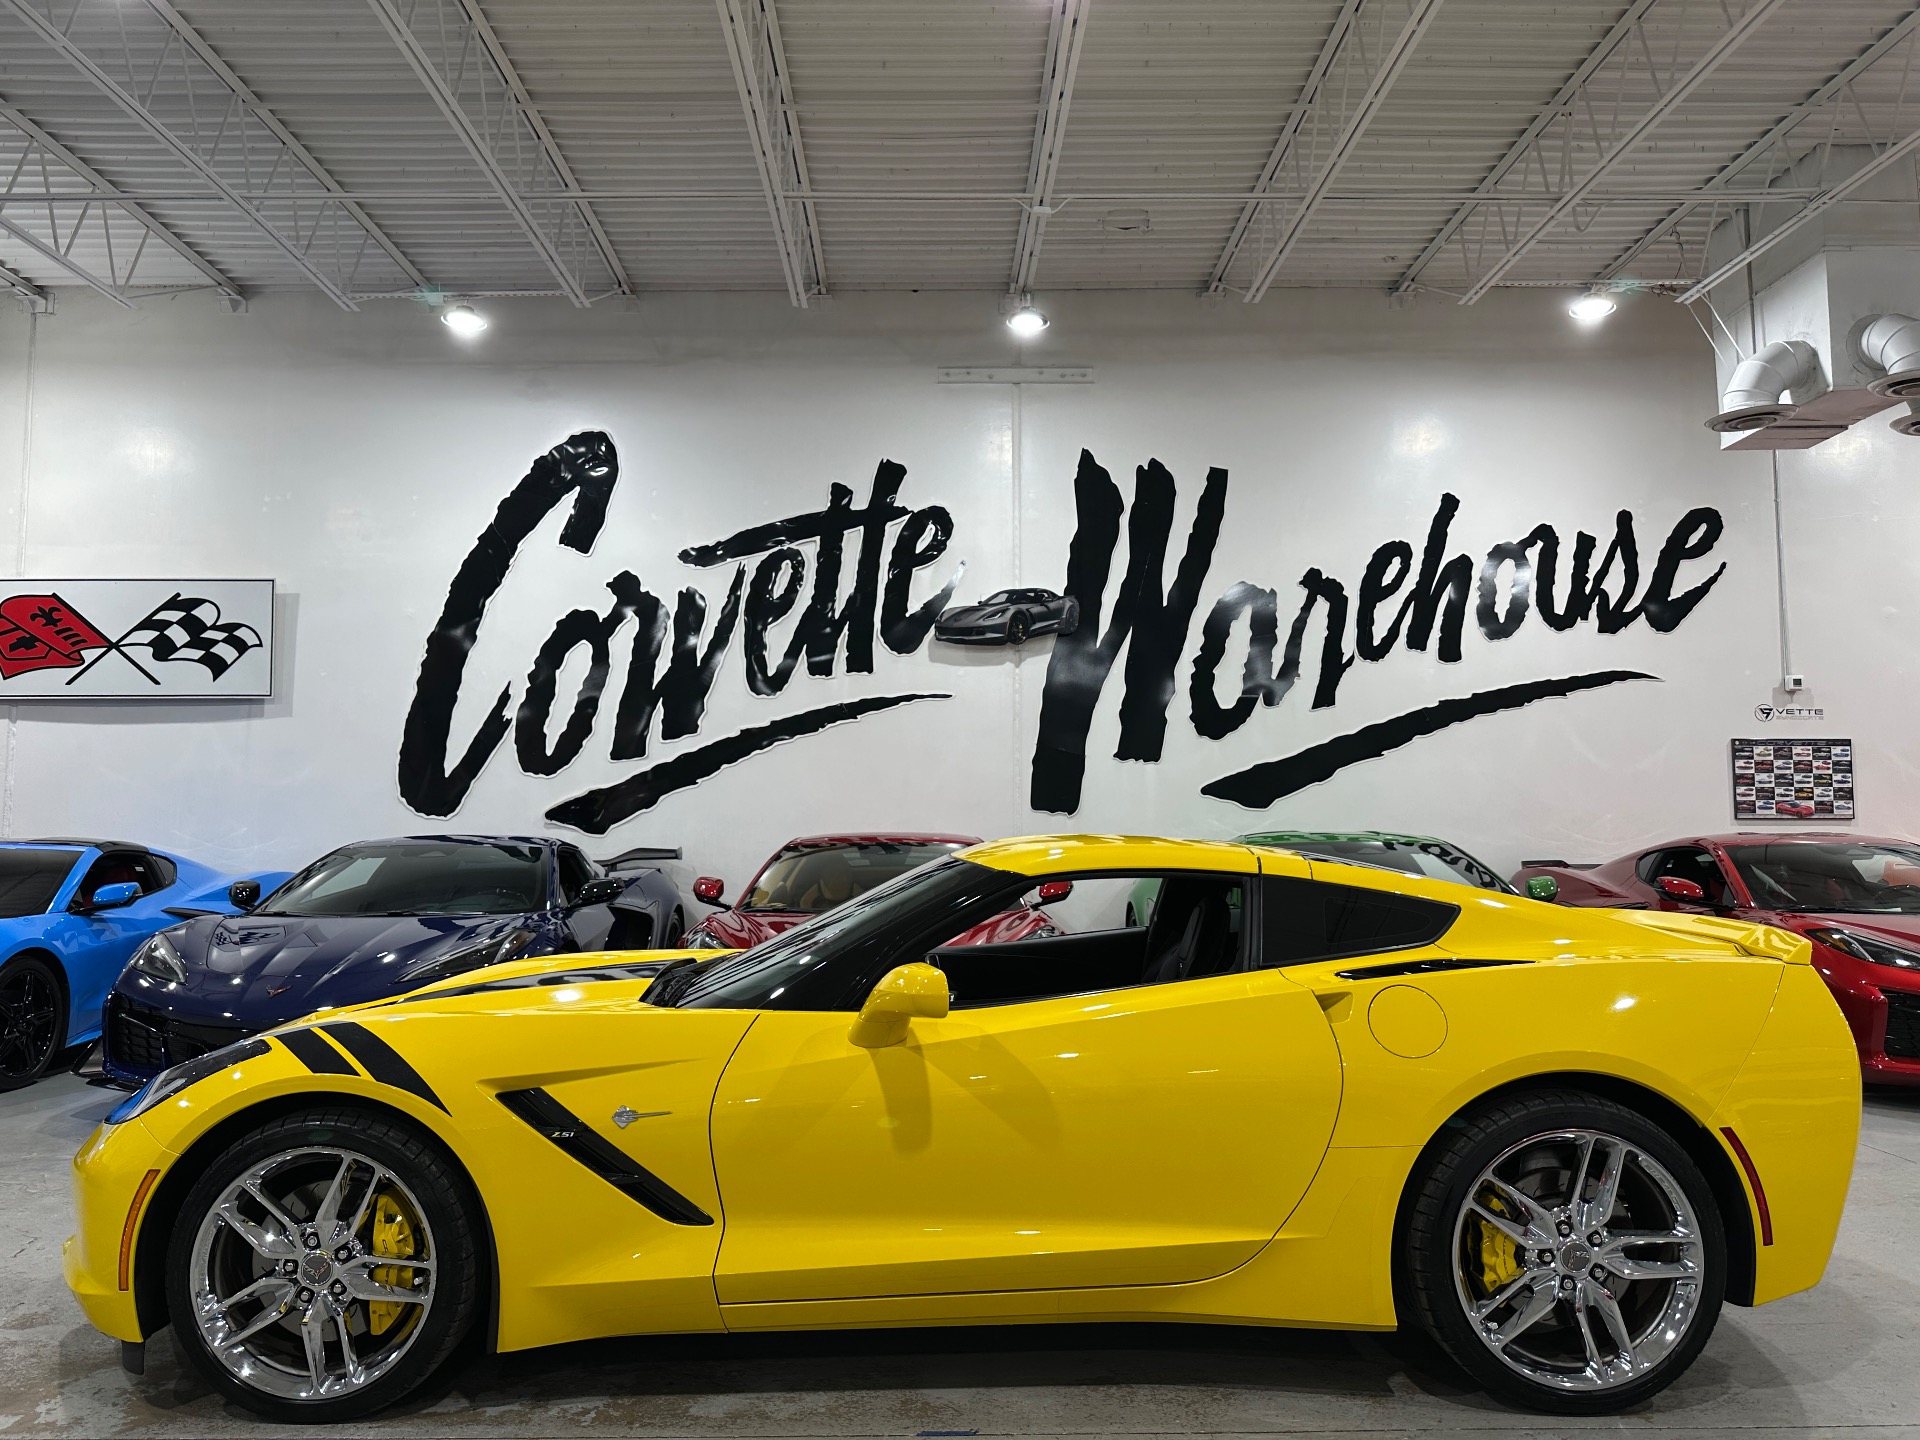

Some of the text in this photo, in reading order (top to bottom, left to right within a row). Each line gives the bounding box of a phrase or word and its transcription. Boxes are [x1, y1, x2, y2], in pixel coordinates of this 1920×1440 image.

[397, 430, 1726, 819] Corvette Warehouse
[1775, 708, 1824, 716] VETTE
